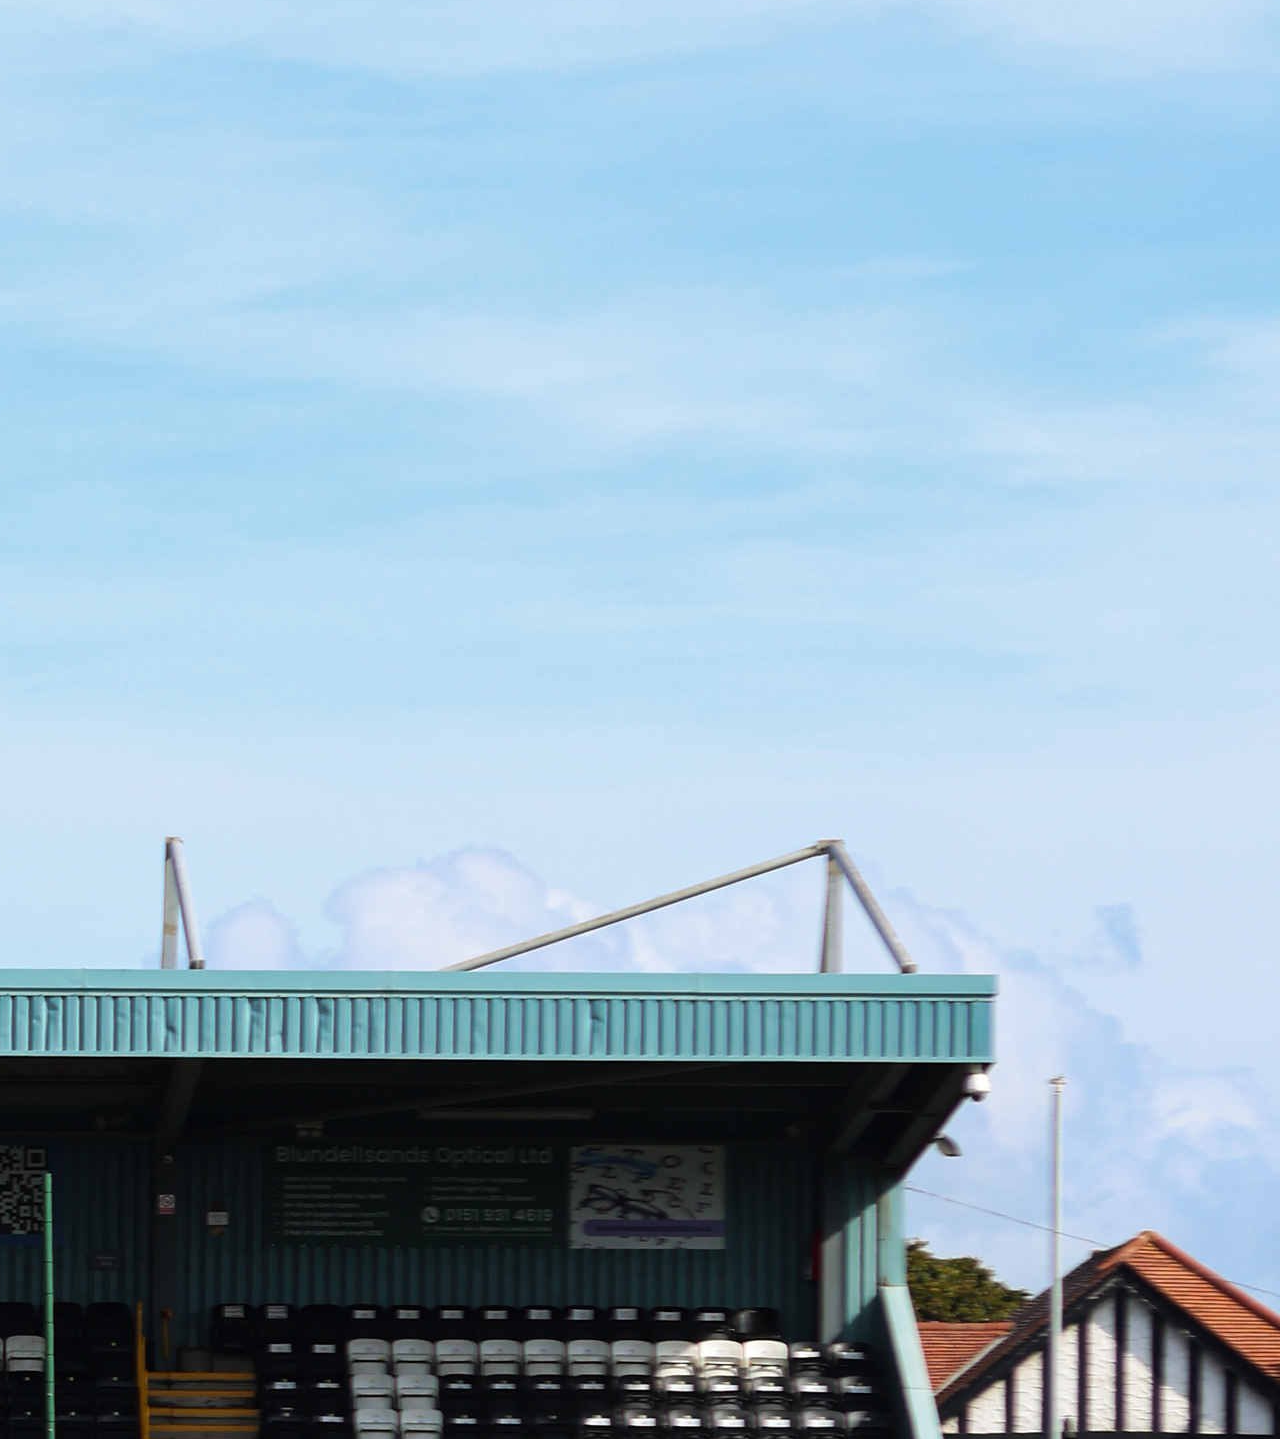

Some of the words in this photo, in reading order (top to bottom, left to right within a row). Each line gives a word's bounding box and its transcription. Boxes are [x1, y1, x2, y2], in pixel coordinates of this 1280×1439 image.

[275, 1146, 432, 1163] Blundellsands
[435, 1146, 514, 1169] Optical
[518, 1147, 554, 1164] Ltd
